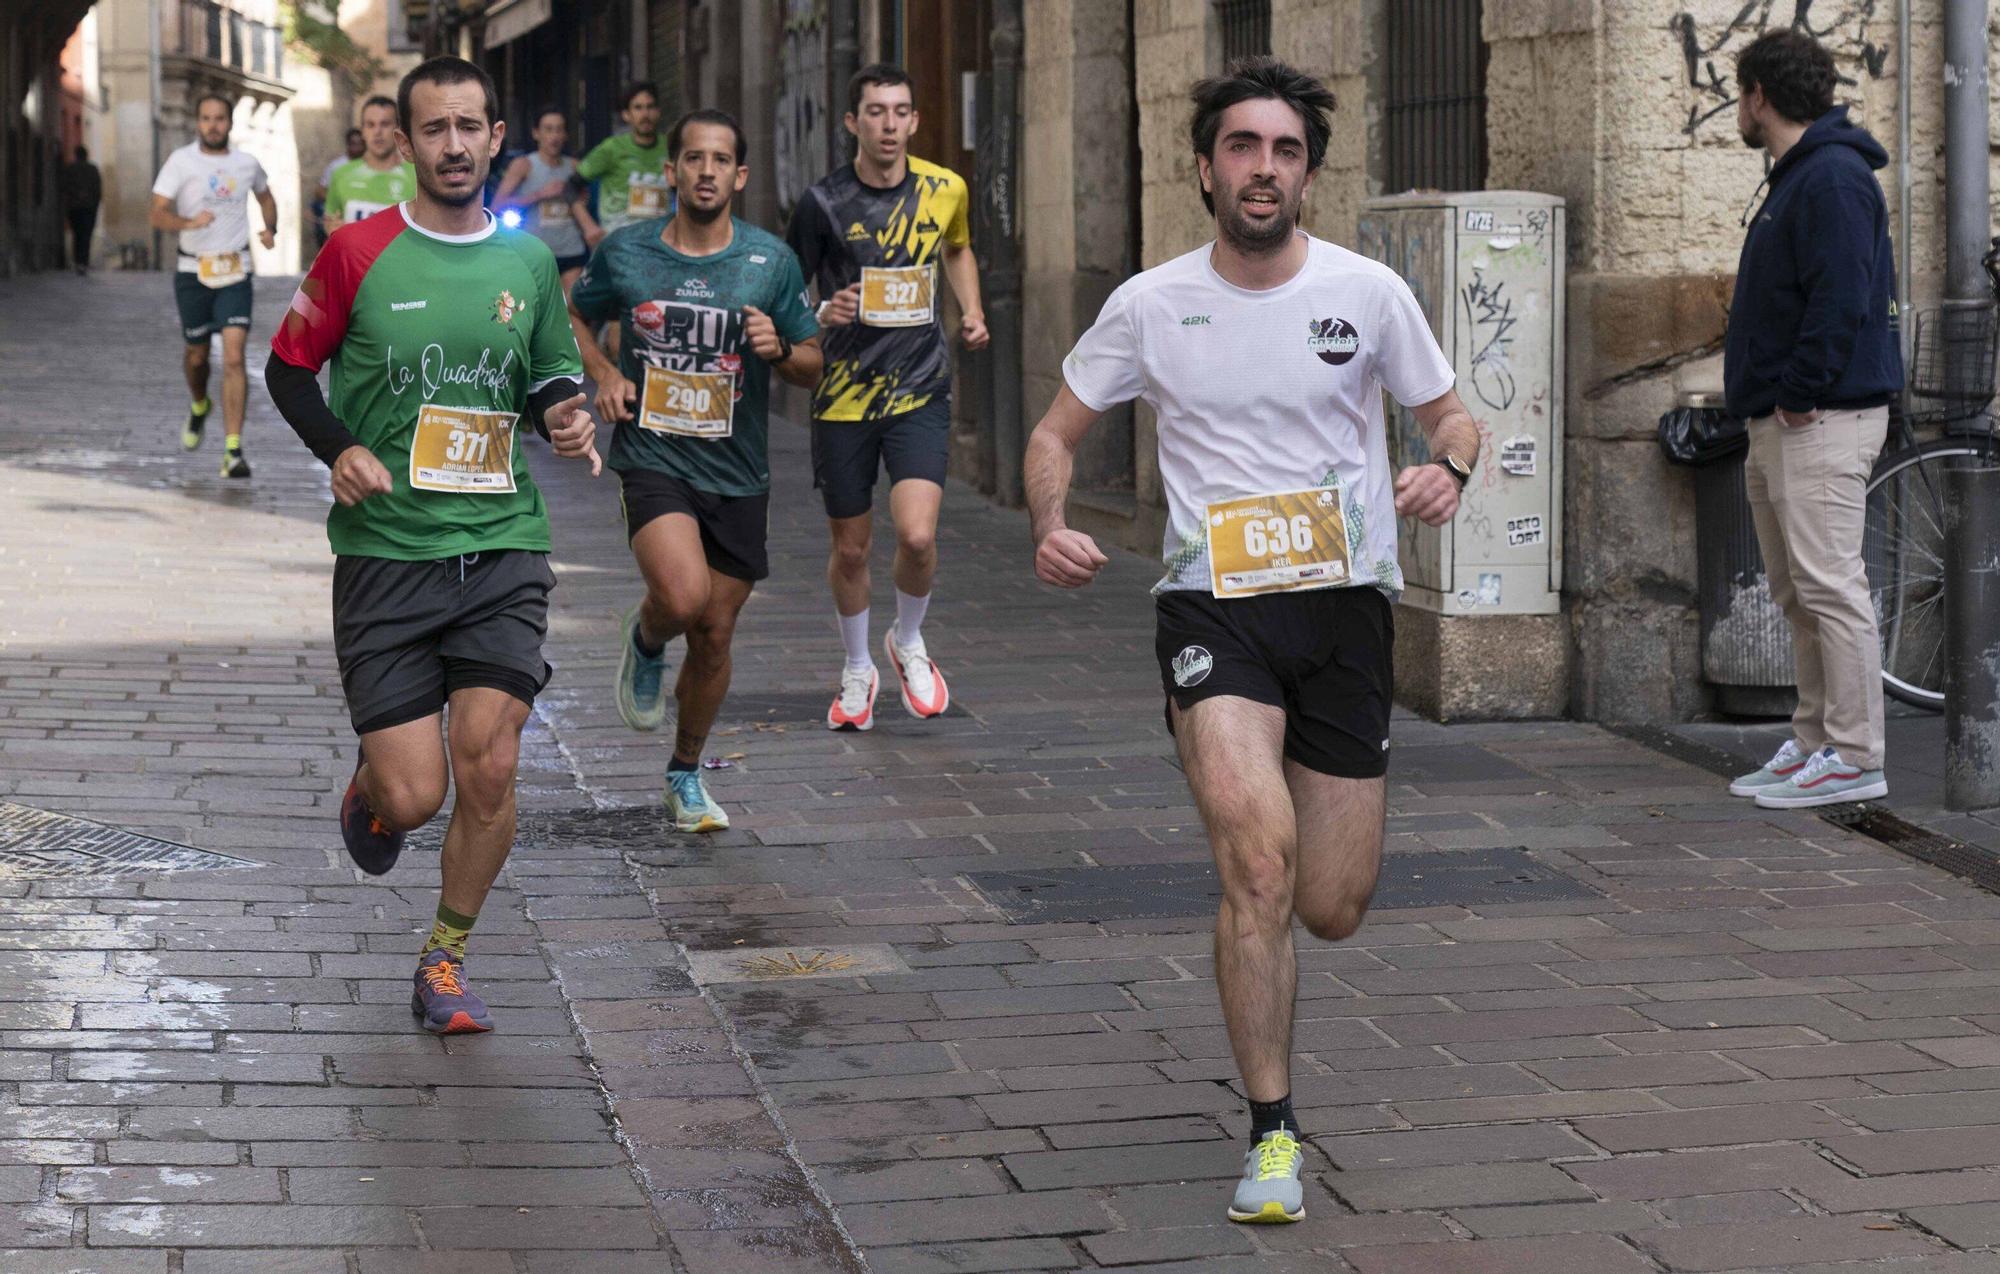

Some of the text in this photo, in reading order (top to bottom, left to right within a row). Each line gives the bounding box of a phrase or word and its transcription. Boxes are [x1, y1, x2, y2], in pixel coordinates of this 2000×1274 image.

[884, 282, 919, 305] 327
[1181, 314, 1212, 326] 42K
[387, 344, 415, 396] La
[665, 385, 711, 413] 290
[446, 430, 489, 463] 371
[1243, 514, 1314, 558] 636
